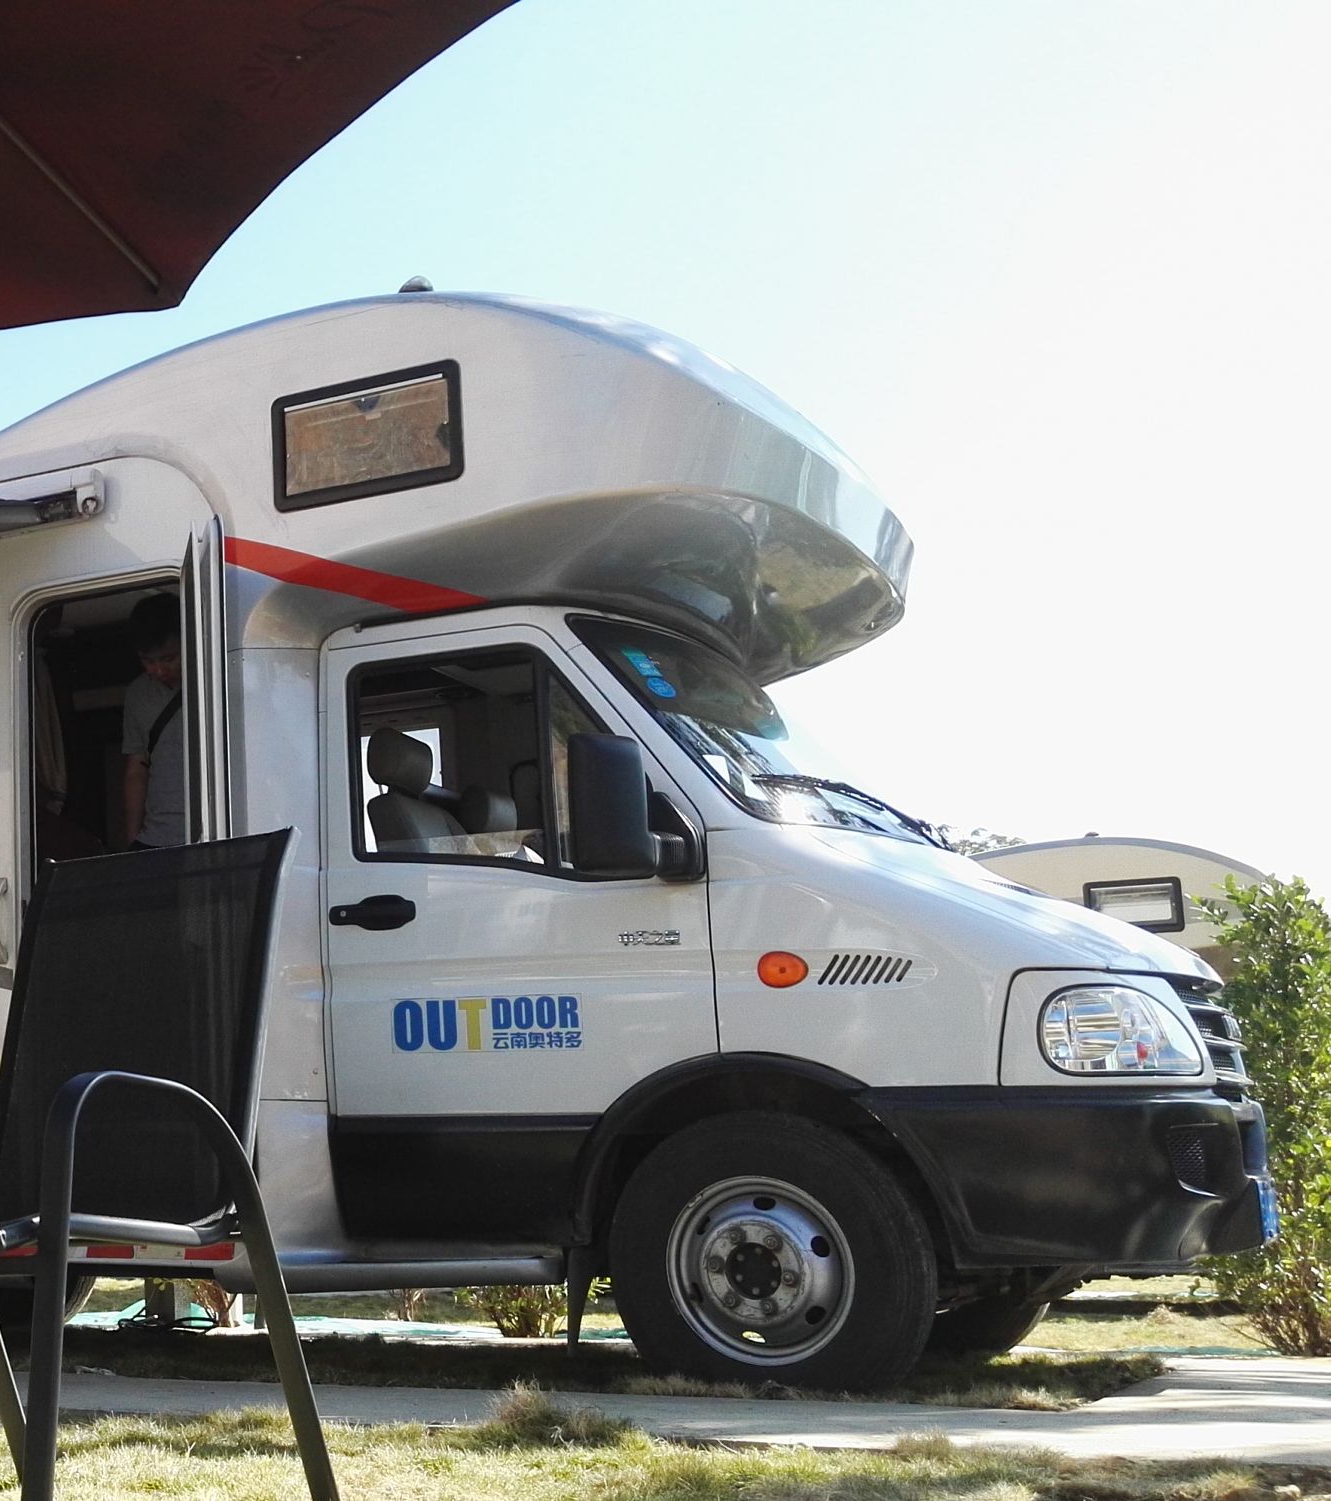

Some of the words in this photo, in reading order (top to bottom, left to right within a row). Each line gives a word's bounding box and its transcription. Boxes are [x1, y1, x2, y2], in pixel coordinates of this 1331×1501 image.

[492, 1031, 583, 1049] 云南奥特多
